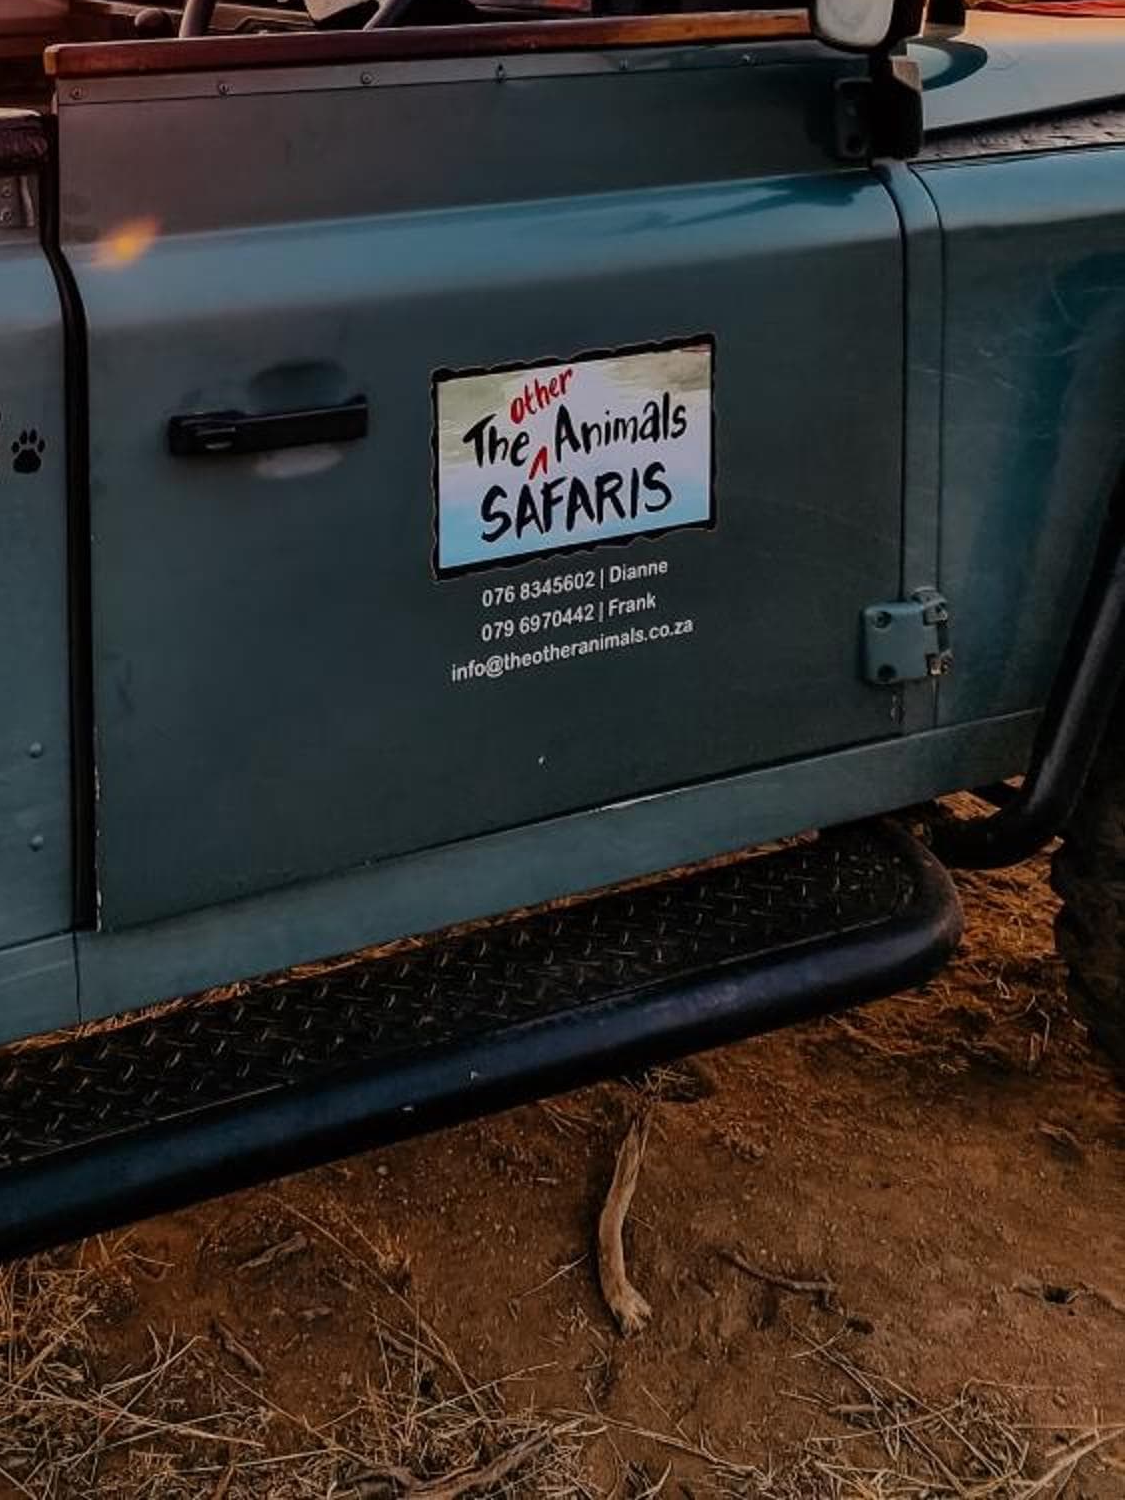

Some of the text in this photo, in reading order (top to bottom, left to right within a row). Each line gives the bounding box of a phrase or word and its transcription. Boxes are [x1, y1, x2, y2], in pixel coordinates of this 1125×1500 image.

[510, 368, 573, 424] other
[463, 392, 687, 467] The Animals
[480, 461, 673, 543] SAFARIS
[481, 580, 516, 607] 076
[519, 570, 596, 601] 8345602
[609, 560, 669, 583] Dianne
[481, 614, 515, 642] 079
[518, 602, 595, 636] 6970442
[608, 593, 657, 618] Frank
[451, 617, 694, 683] info@theotheranimals.co.za
